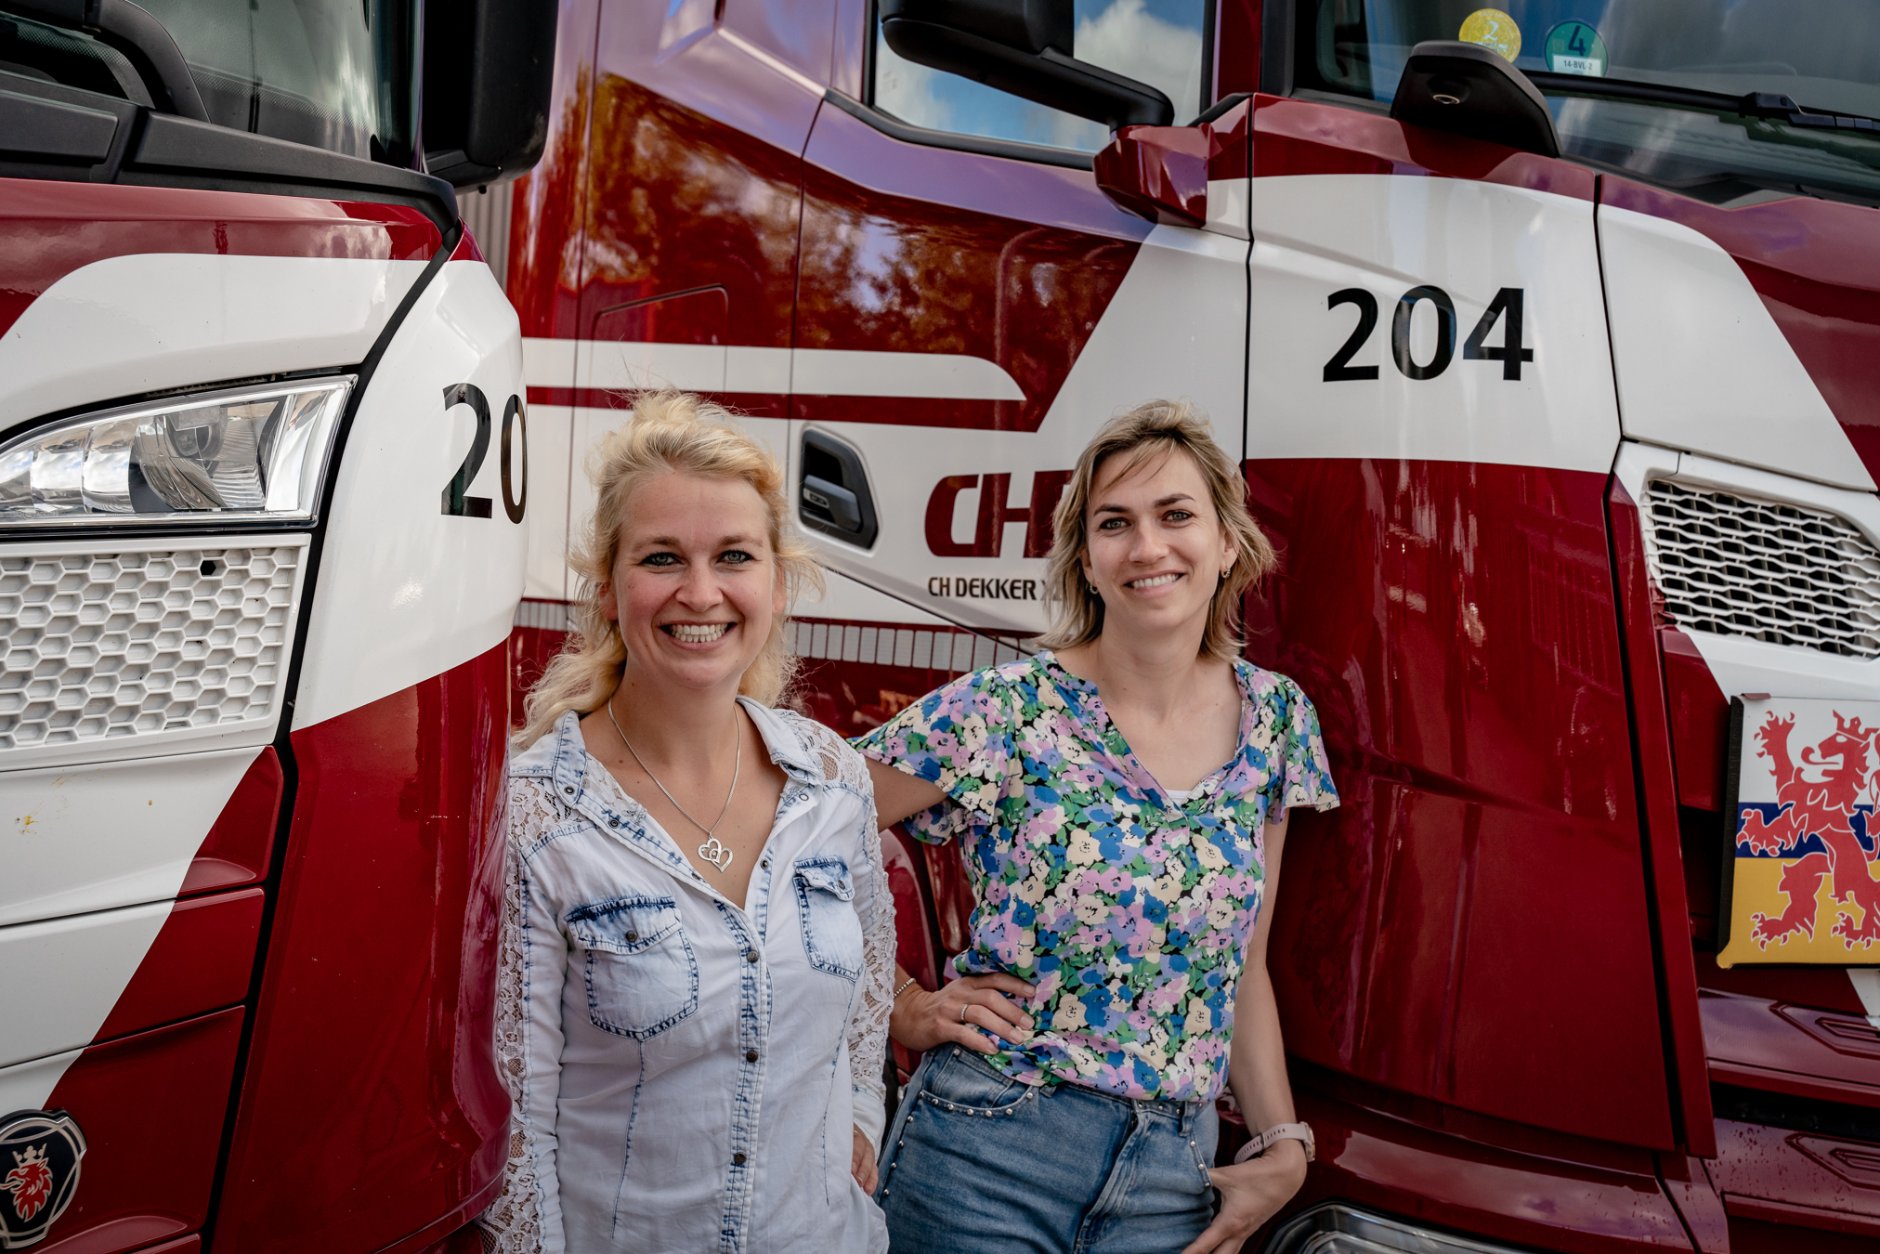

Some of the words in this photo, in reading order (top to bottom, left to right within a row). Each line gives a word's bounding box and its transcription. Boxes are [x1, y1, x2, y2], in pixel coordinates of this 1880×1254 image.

[1483, 20, 1499, 41] 2
[1568, 25, 1586, 57] 4
[1323, 285, 1534, 382] 204
[441, 383, 528, 524] 20
[928, 577, 950, 597] CH
[956, 578, 1037, 600] DEKKER
